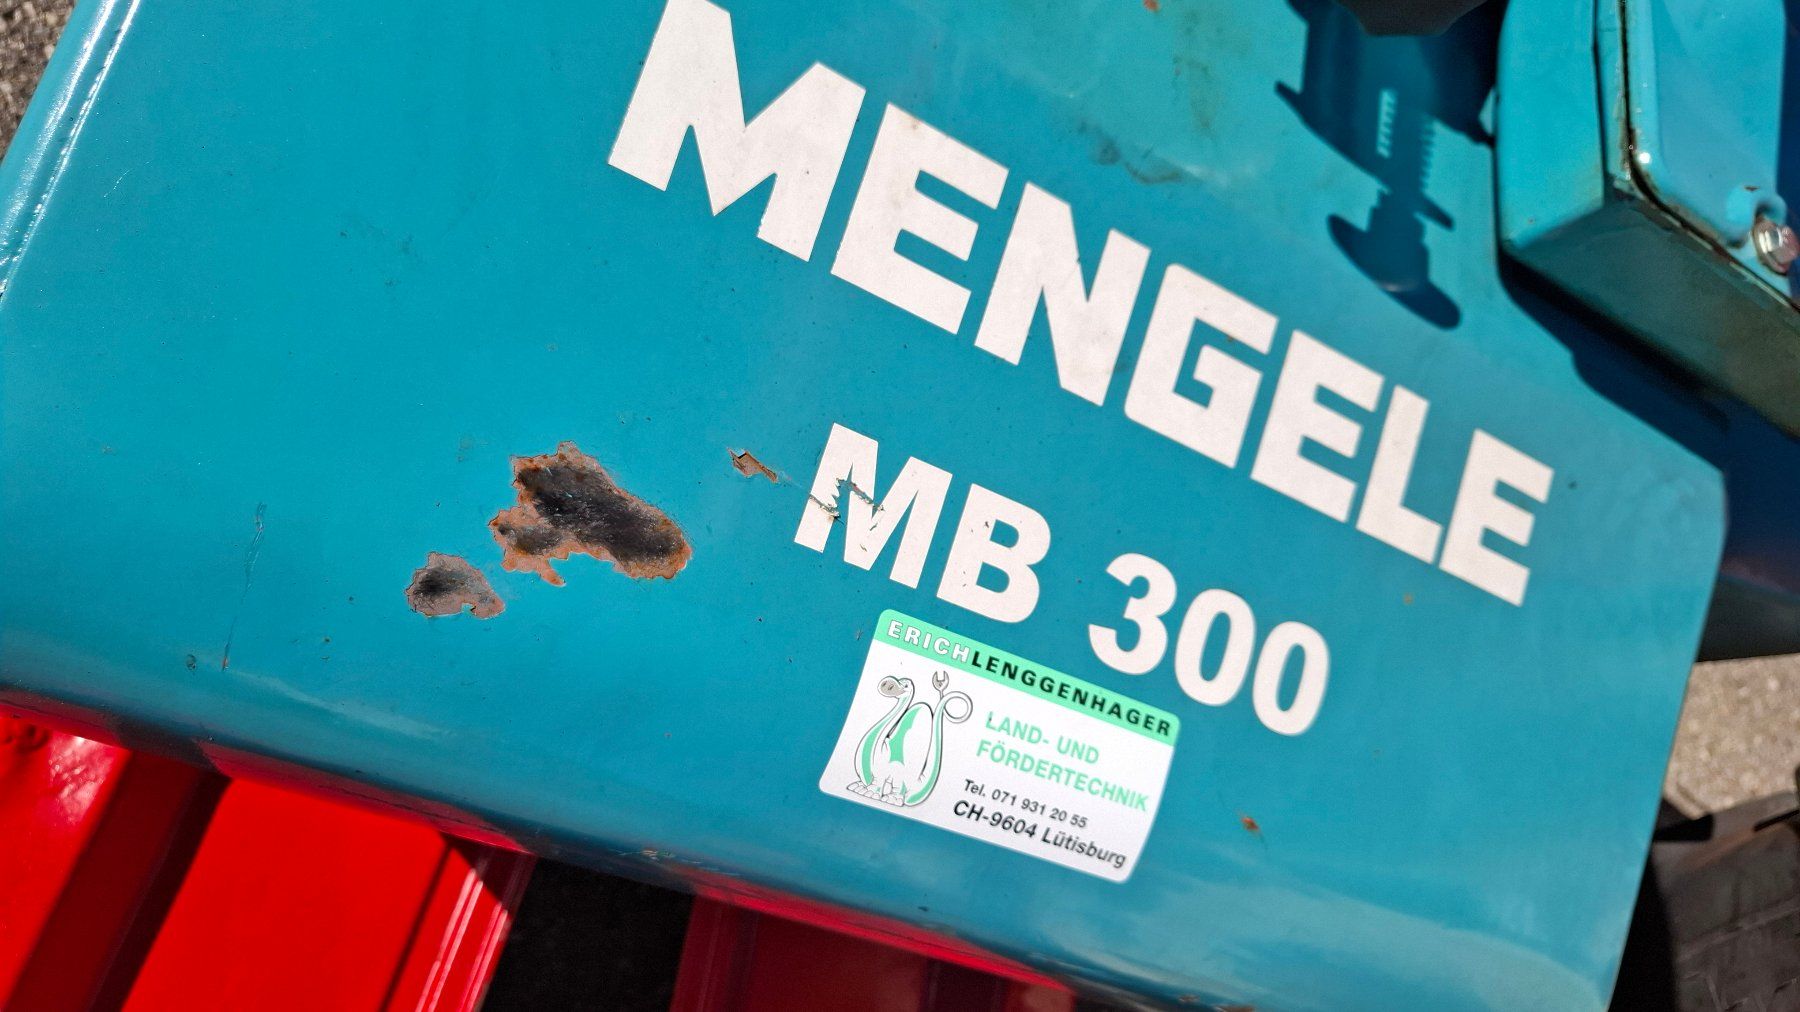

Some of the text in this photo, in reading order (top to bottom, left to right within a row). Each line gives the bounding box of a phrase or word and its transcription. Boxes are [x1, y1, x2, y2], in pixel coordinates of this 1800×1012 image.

[608, 0, 1555, 607] MENGELE
[794, 423, 1331, 736] MB 300
[985, 711, 1100, 765] LAND- UND
[963, 779, 1088, 829] Tel. 071 931 20 55
[975, 738, 1149, 813] FÖRDERTECHNIK
[953, 800, 1127, 870] CH-9604 Lütisburg
